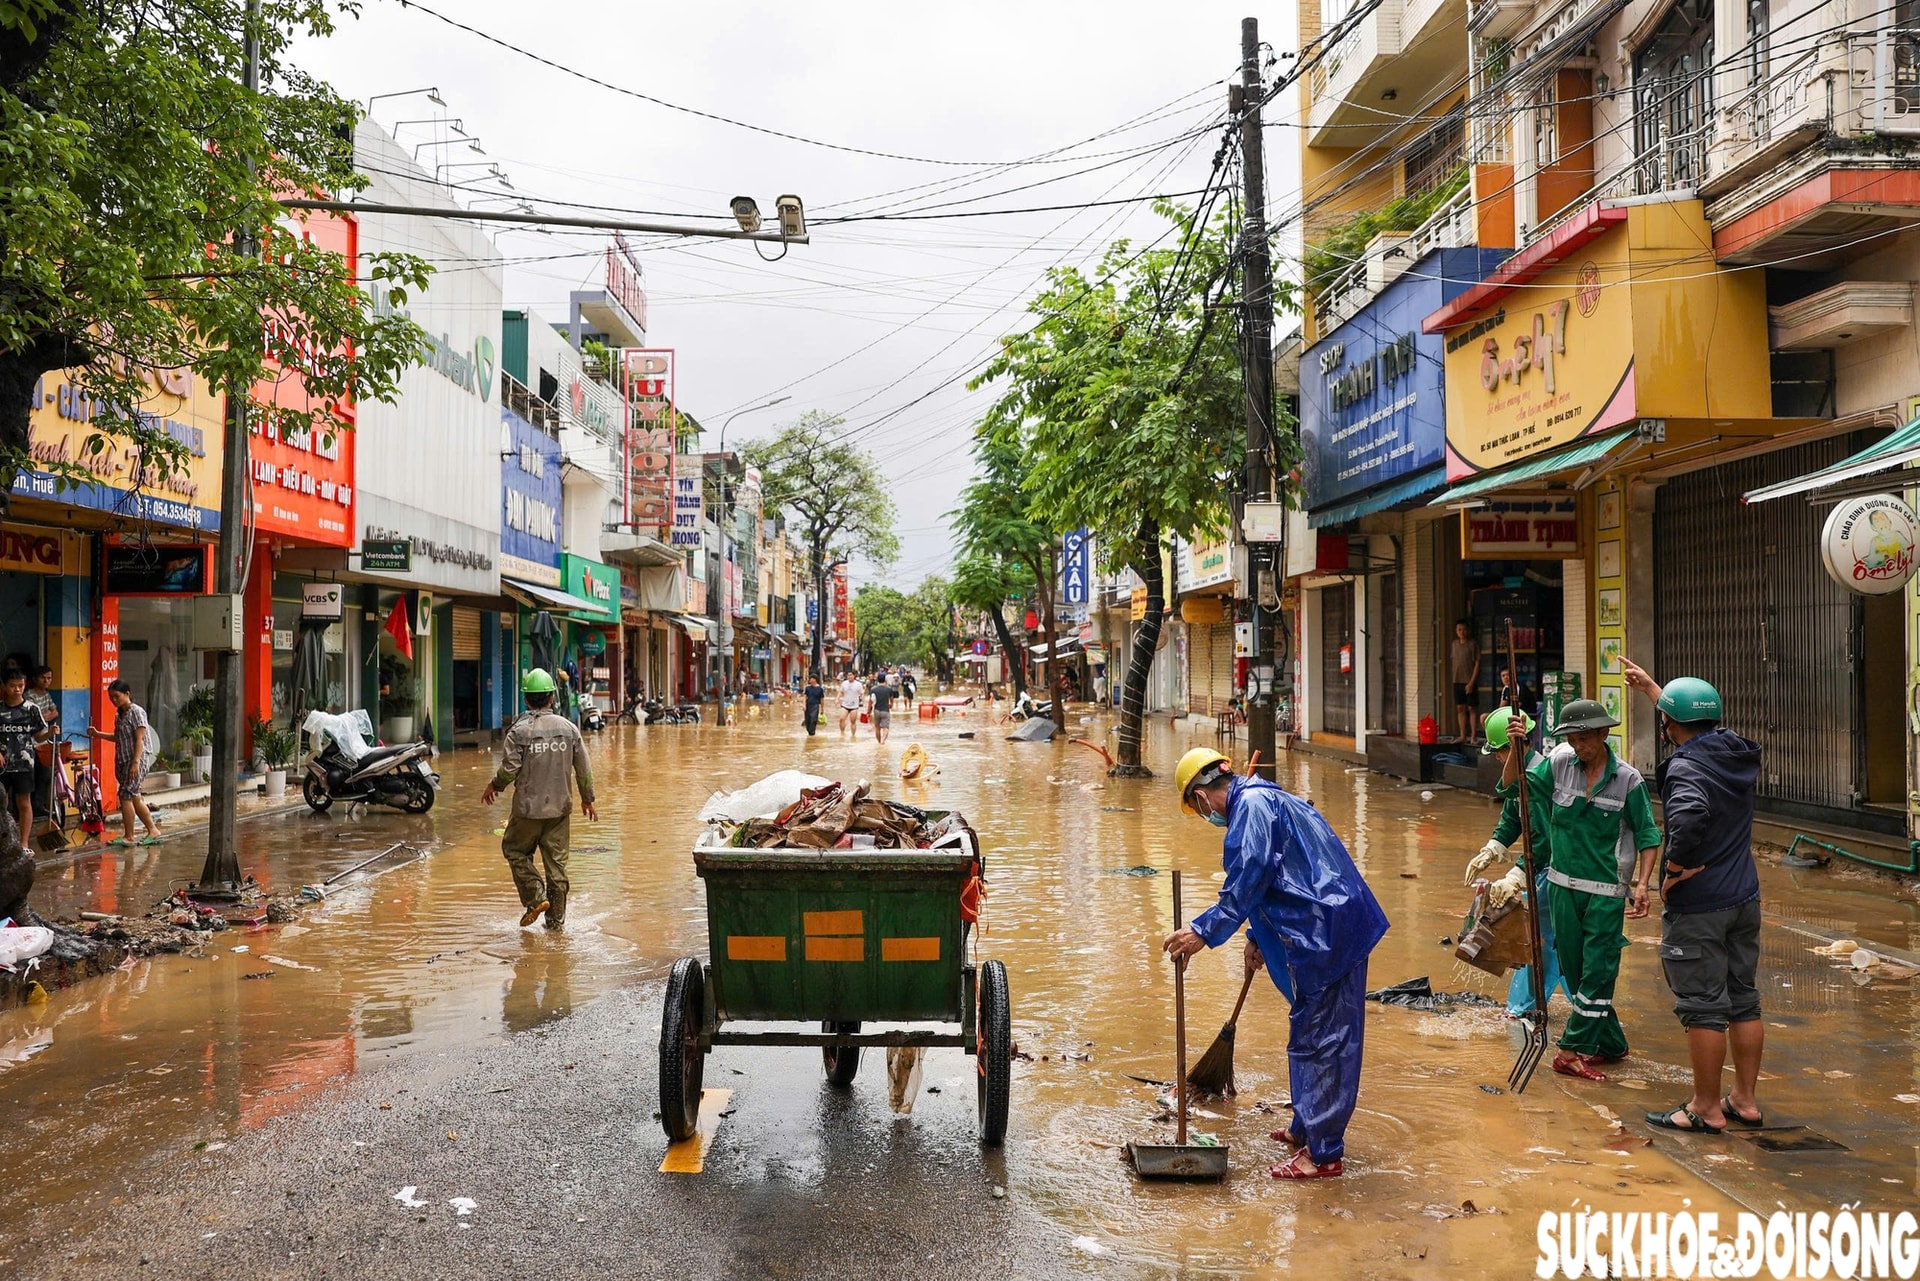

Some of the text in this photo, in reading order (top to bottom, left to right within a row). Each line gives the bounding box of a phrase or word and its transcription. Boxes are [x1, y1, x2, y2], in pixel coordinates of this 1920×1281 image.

[1320, 342, 1344, 375] SHOP
[255, 459, 276, 486] LẠNH
[678, 477, 694, 491] TÍN
[1849, 506, 1866, 521] DINH
[1890, 502, 1903, 513] CAO
[676, 514, 696, 527] DUY
[671, 531, 700, 545] MONG
[1470, 514, 1577, 548] THÀNH TỊNH
[365, 551, 406, 560] Vietcombank
[370, 559, 401, 568] 24h ATM
[1066, 534, 1083, 602] CHÂU
[304, 594, 328, 603] VCBS
[102, 622, 118, 635] BÁN
[264, 616, 275, 631] 37
[103, 639, 117, 653] TRẢ
[101, 658, 119, 671] GÓP
